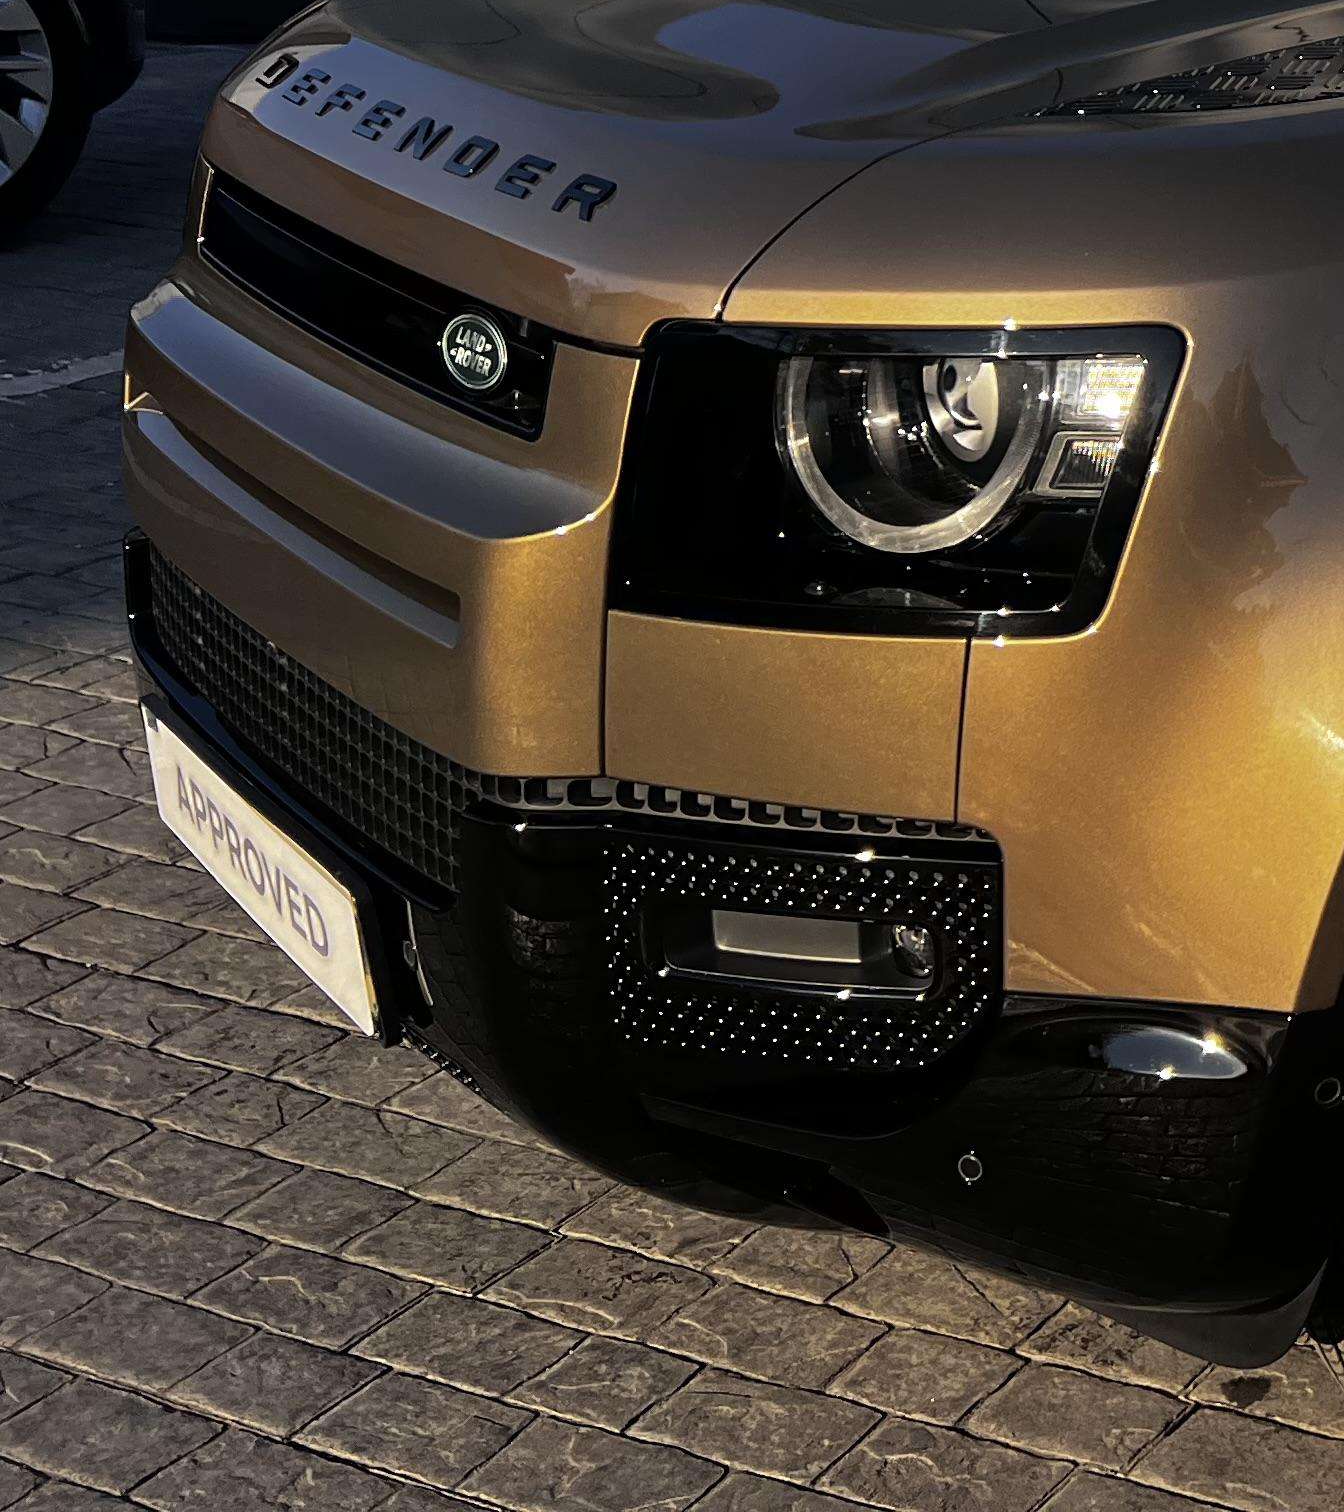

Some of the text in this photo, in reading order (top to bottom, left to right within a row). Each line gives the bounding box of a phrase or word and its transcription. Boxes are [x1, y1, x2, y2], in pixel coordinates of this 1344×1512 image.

[255, 53, 618, 222] DEFENDER
[455, 326, 486, 352] LAND
[455, 347, 491, 376] ROVER
[176, 765, 330, 958] APPROVED
